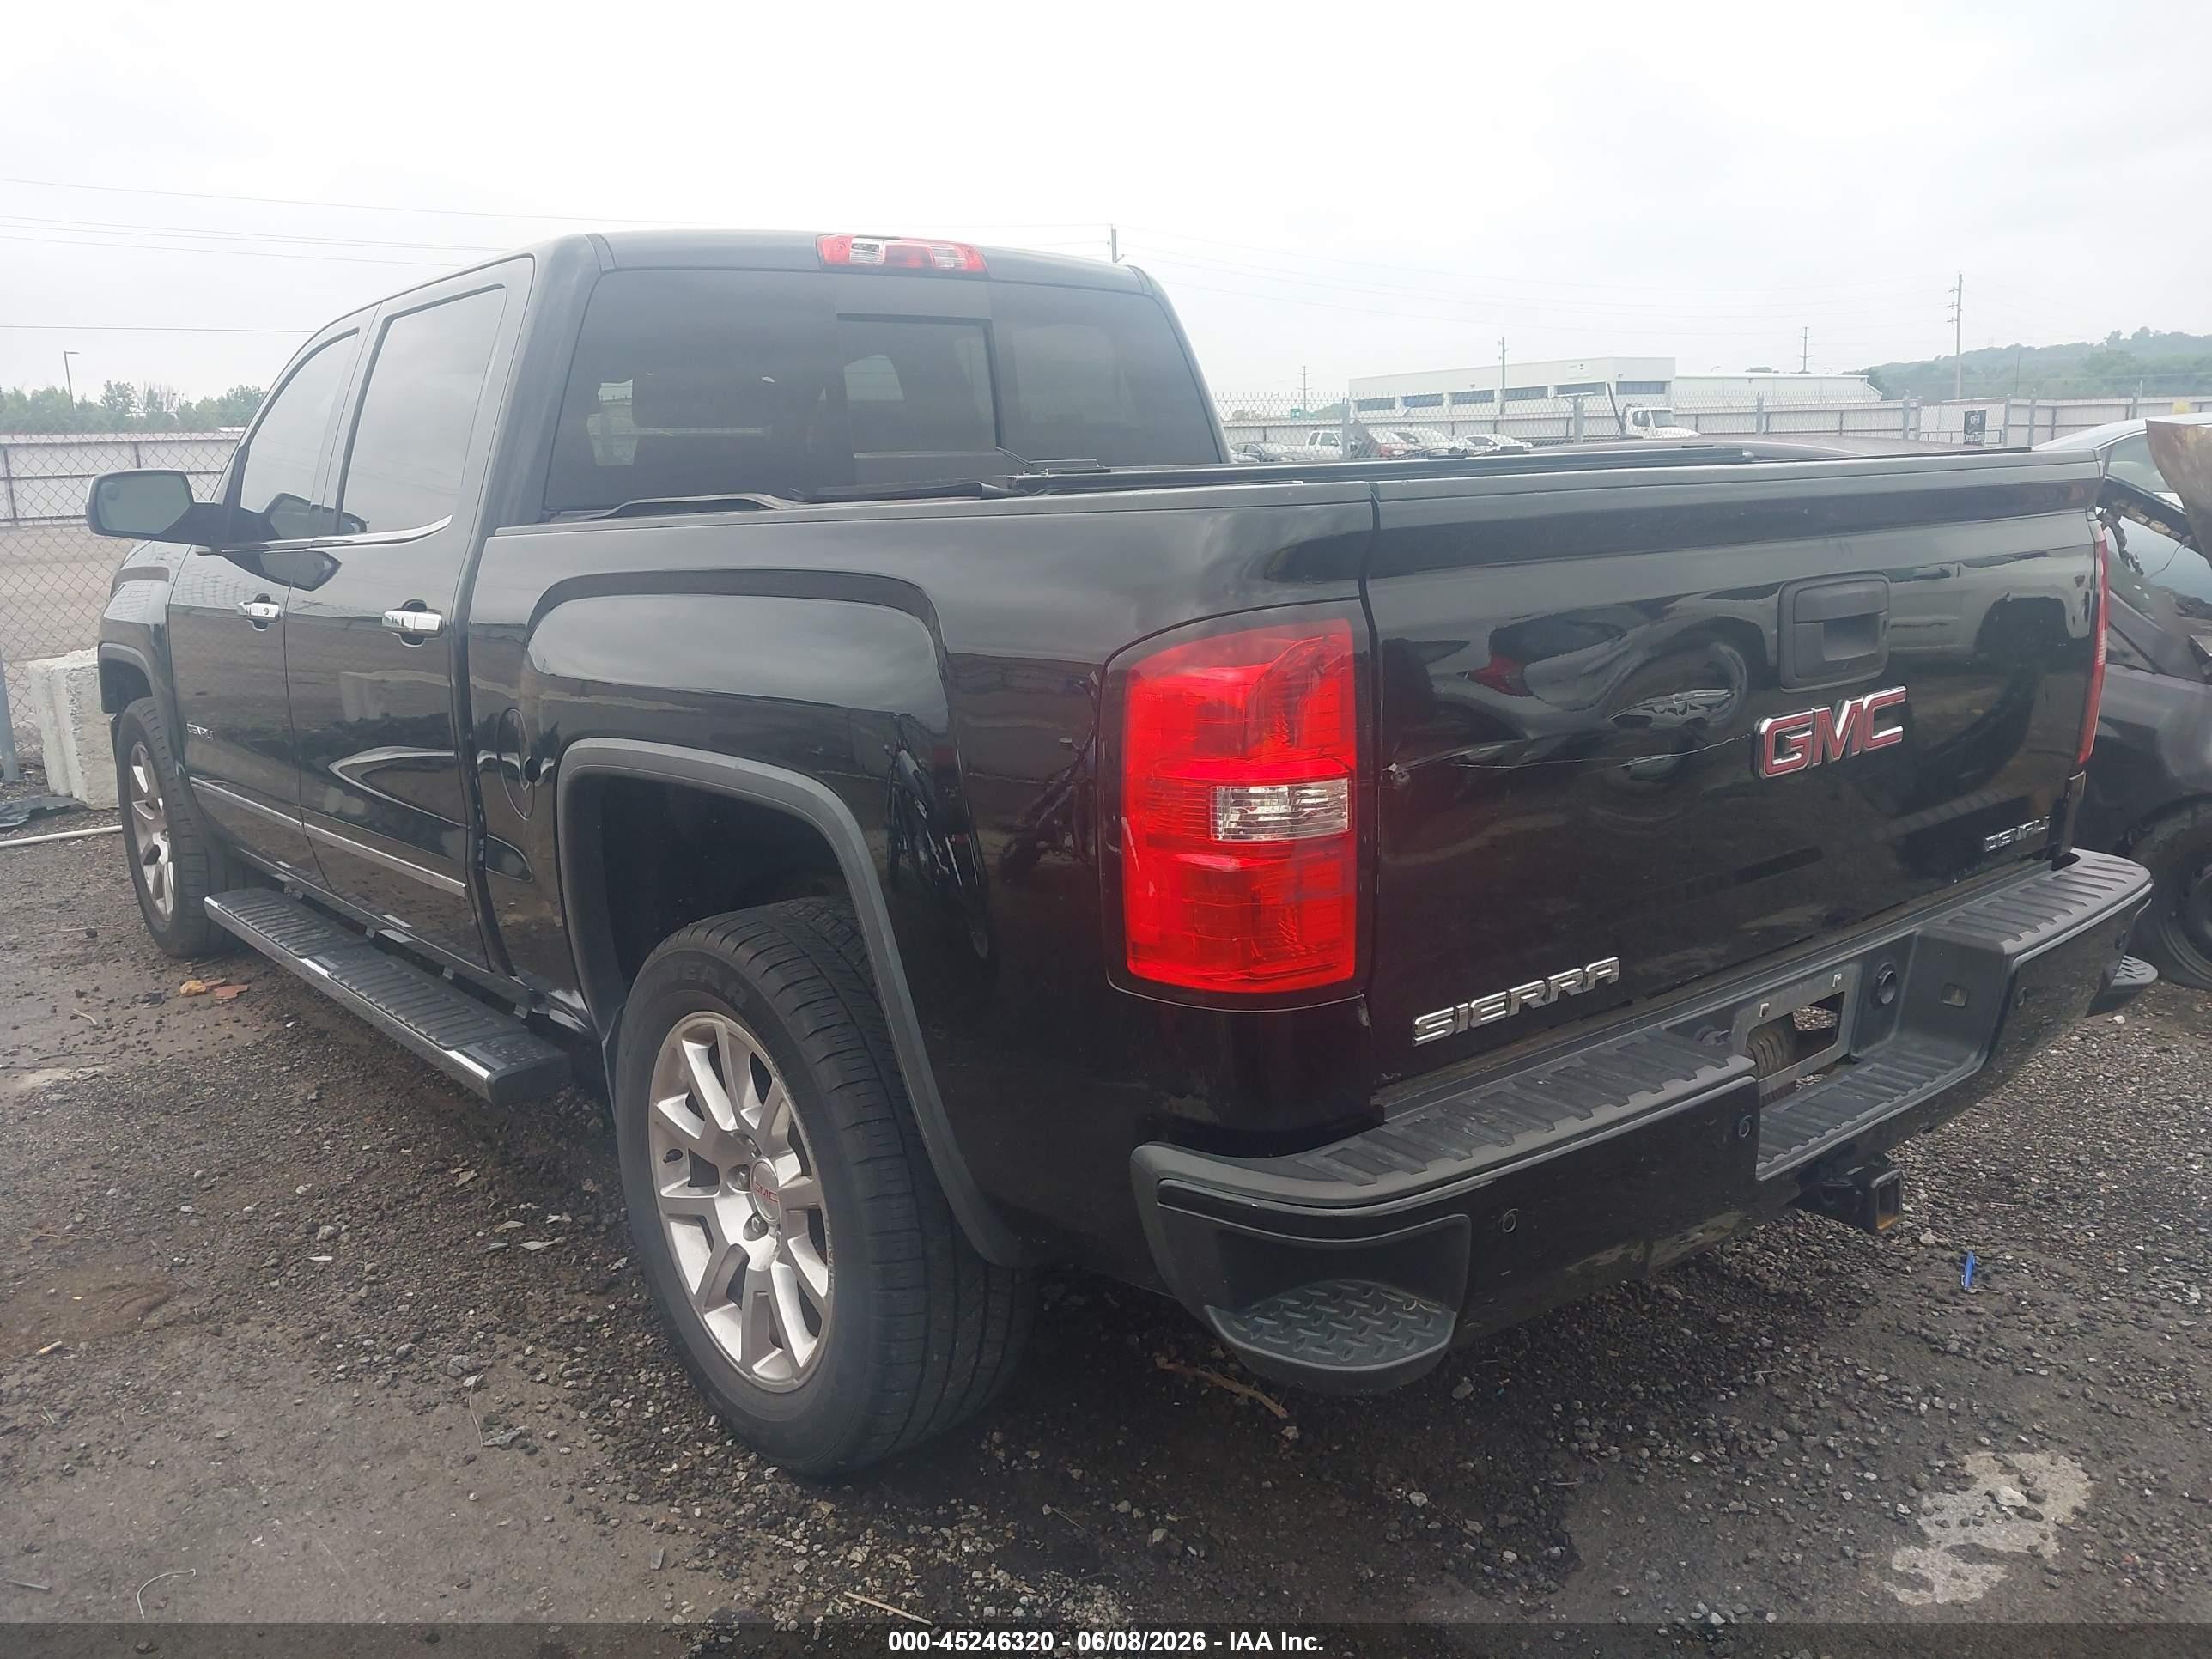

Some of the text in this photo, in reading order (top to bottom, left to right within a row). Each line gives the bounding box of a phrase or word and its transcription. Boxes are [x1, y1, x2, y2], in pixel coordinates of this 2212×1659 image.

[1757, 686, 1907, 778] GMC
[1413, 957, 1620, 1046] SIERRA
[755, 1182, 779, 1203] GMC
